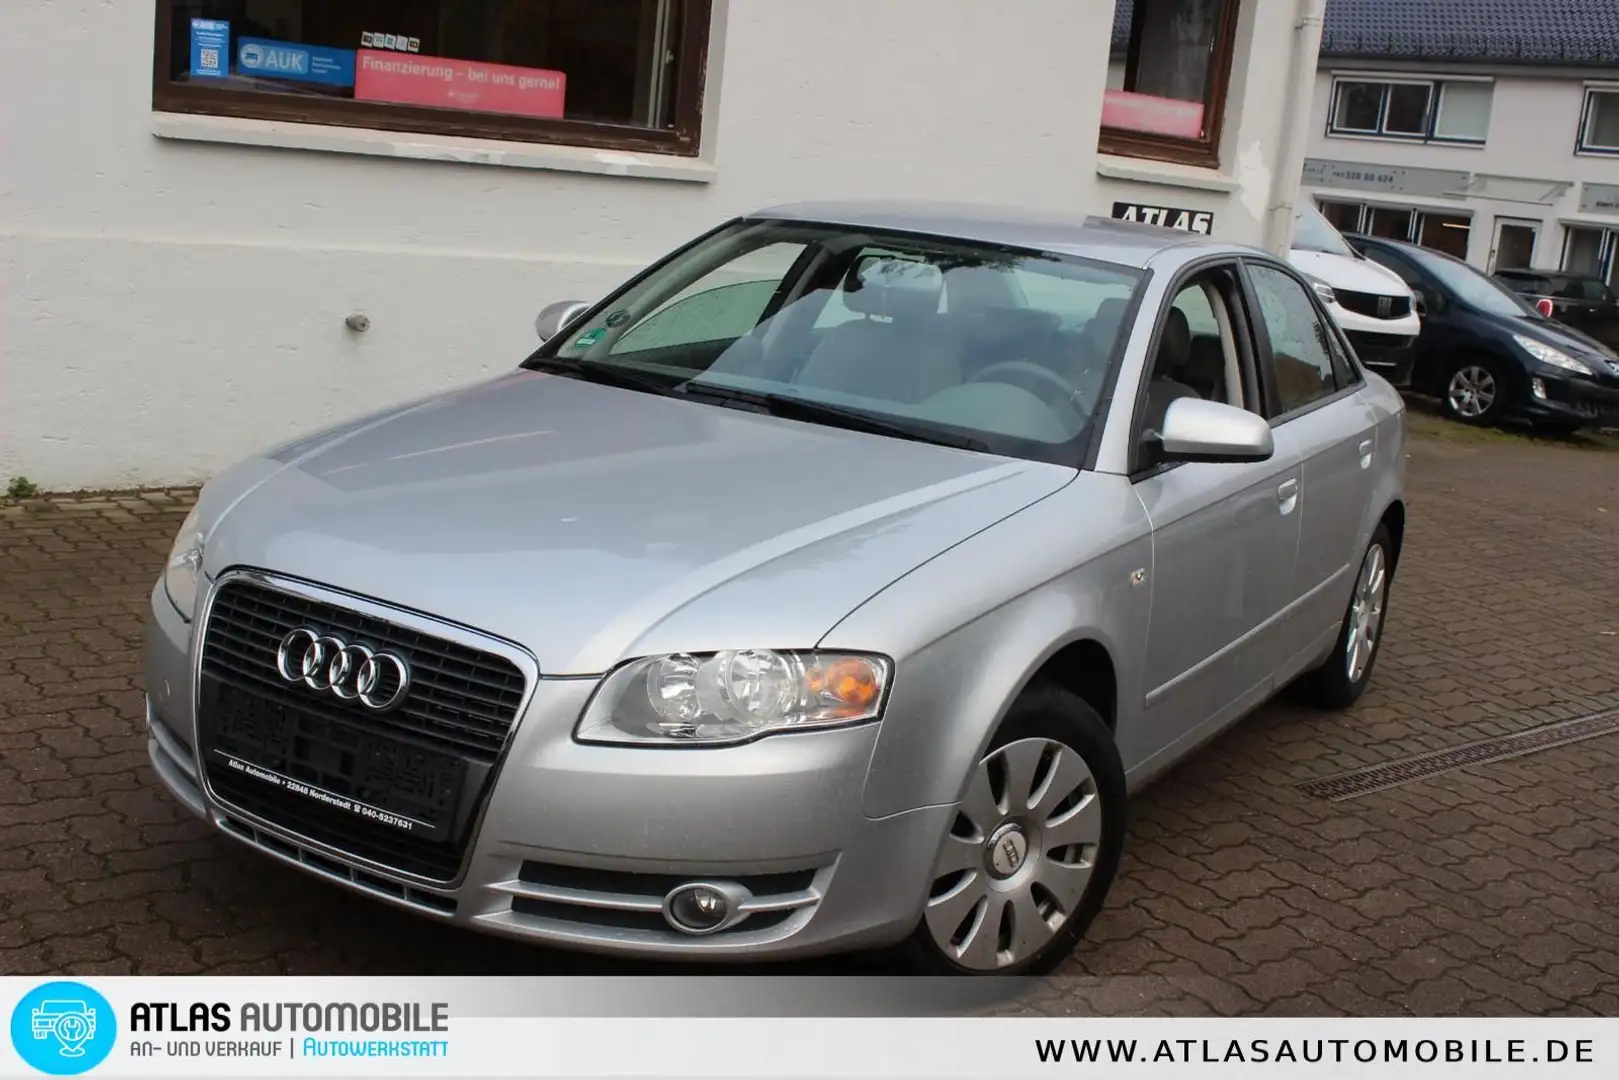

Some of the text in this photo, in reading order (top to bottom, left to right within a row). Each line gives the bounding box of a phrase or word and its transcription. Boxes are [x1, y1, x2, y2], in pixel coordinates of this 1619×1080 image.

[264, 50, 303, 73] AUK
[362, 55, 454, 81] Finanzierung
[468, 68, 488, 83] bei
[492, 72, 515, 86] uns
[518, 76, 560, 91] gerne!
[228, 759, 413, 830] Atlas Automobile 22848 Norderstedt 040-5237631
